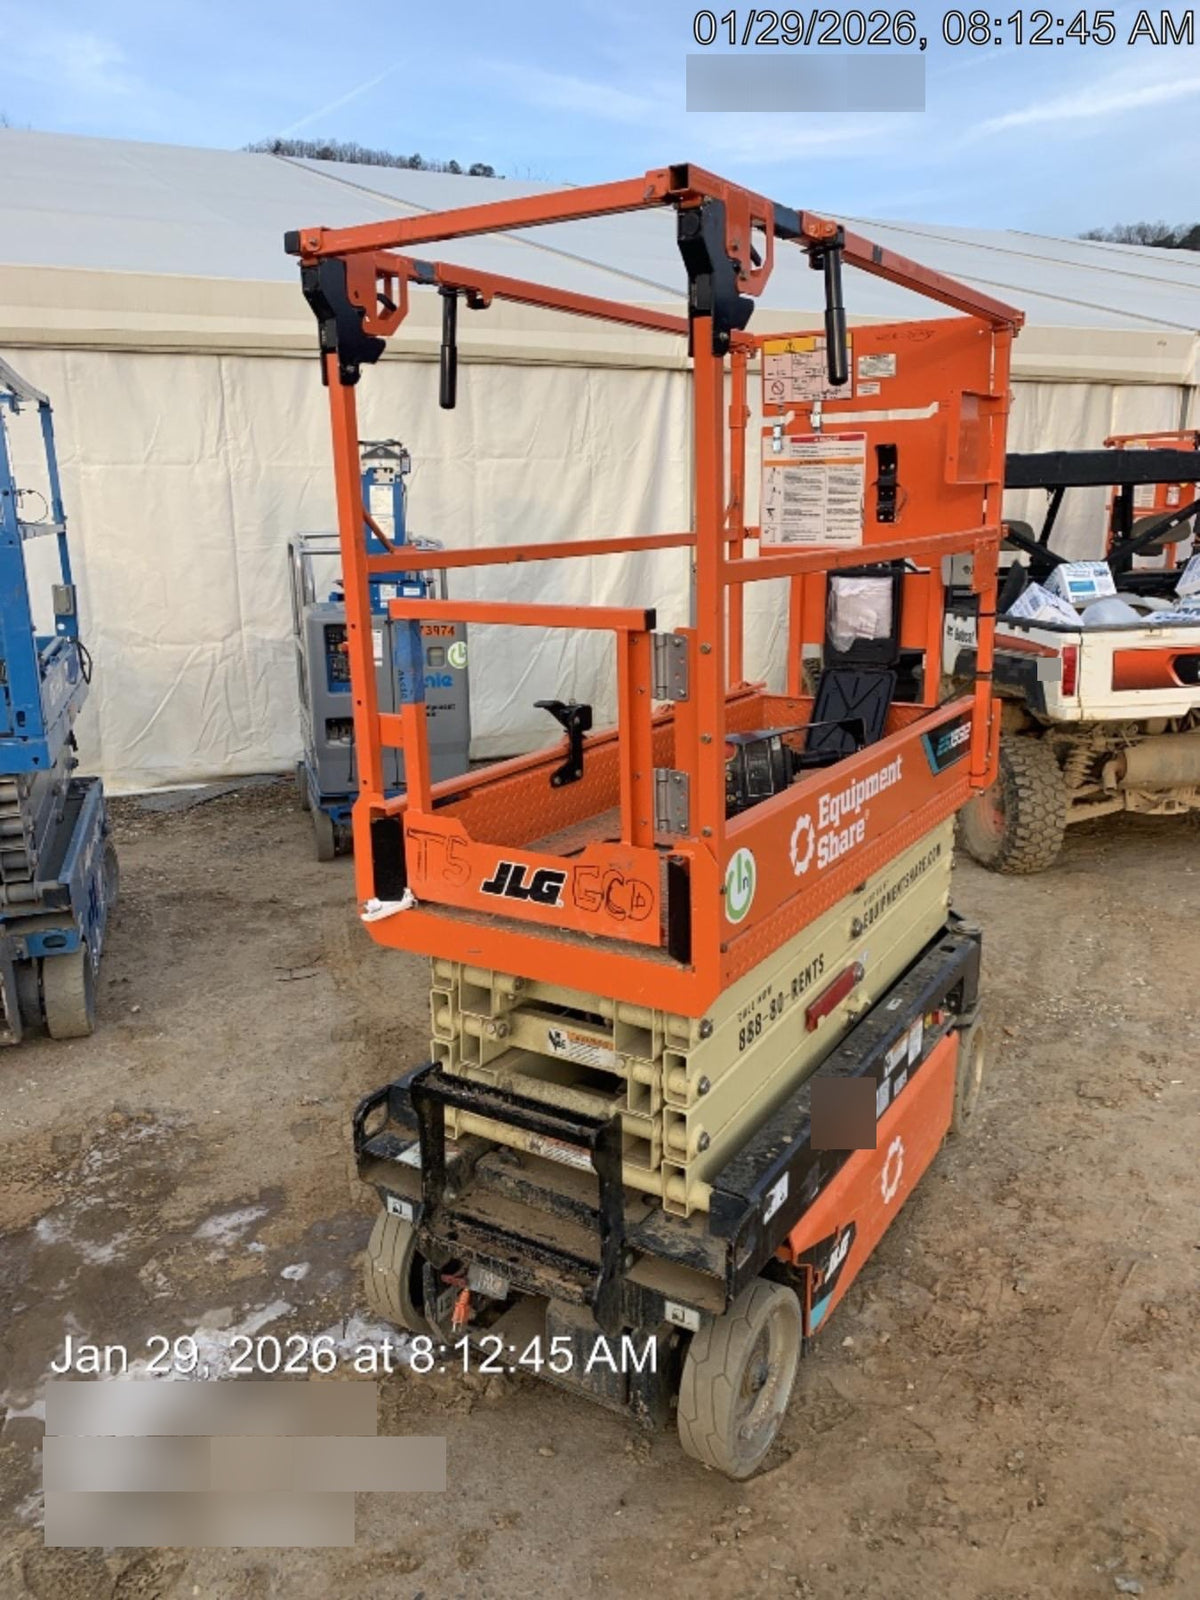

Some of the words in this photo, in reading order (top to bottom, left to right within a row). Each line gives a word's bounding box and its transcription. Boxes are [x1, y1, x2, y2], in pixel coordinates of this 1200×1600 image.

[818, 754, 903, 830] Equipment
[817, 818, 865, 870] Share
[480, 860, 567, 907] JLG
[738, 952, 825, 1052] 888-80-RENTS
